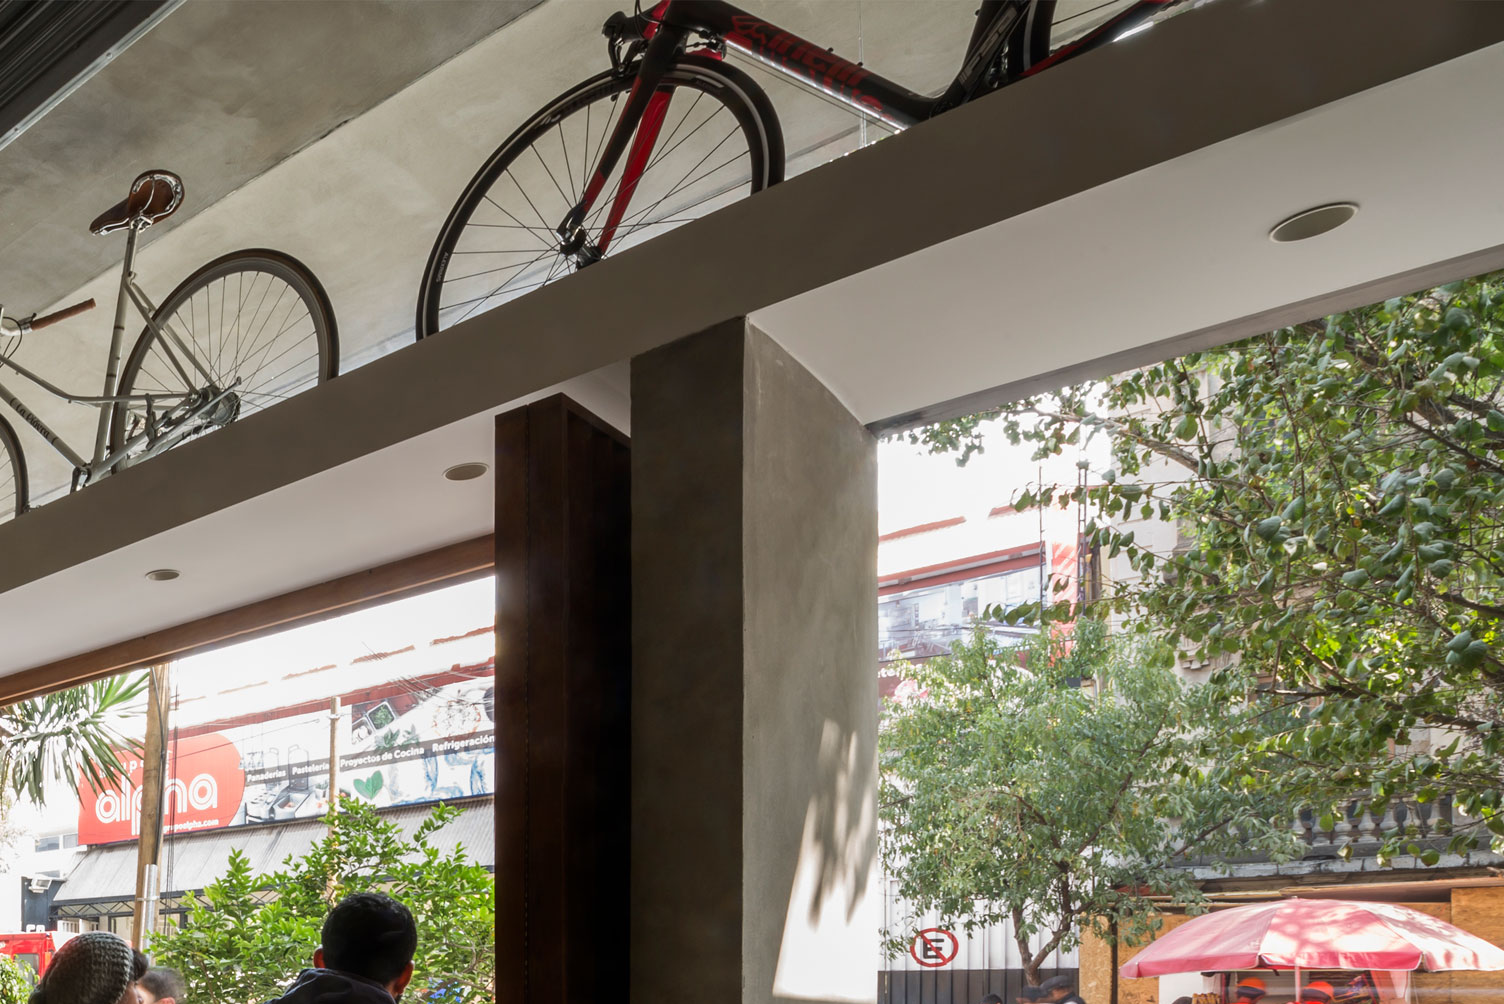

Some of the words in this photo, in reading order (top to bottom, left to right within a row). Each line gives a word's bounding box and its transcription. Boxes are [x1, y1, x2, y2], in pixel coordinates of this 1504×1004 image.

[340, 755, 382, 768] Proyectos
[381, 752, 393, 761] de
[394, 747, 425, 759] Cocina
[923, 939, 945, 959] E
